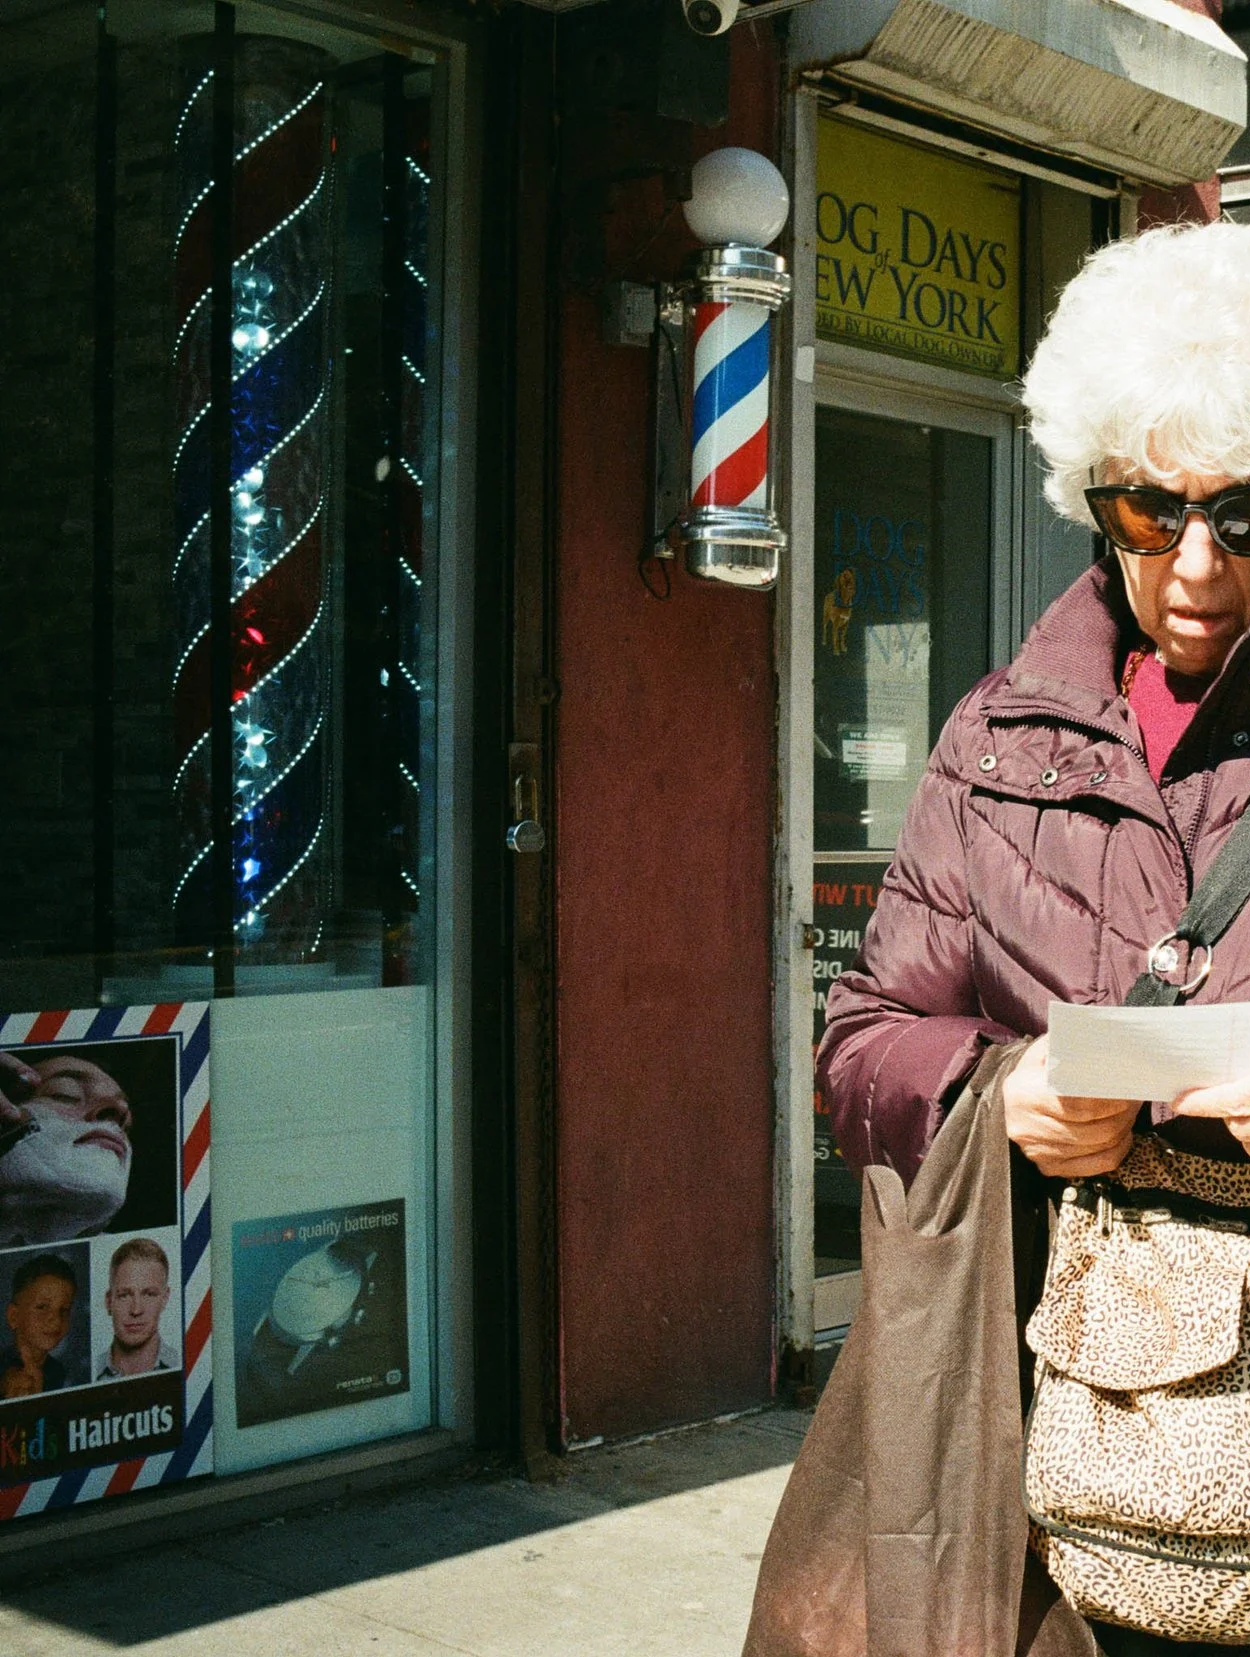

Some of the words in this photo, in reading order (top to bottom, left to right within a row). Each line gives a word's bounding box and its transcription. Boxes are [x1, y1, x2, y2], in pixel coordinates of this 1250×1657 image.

[816, 192, 878, 255] OG
[897, 205, 1007, 290] DAYS
[816, 254, 876, 311] EW
[887, 265, 1002, 343] YORK
[832, 508, 925, 568] DOG
[833, 560, 924, 617] DAYS
[298, 1219, 342, 1242] quality
[344, 1211, 400, 1231] batteries
[0, 1416, 58, 1468] Kids
[68, 1404, 174, 1453] Haircuts
